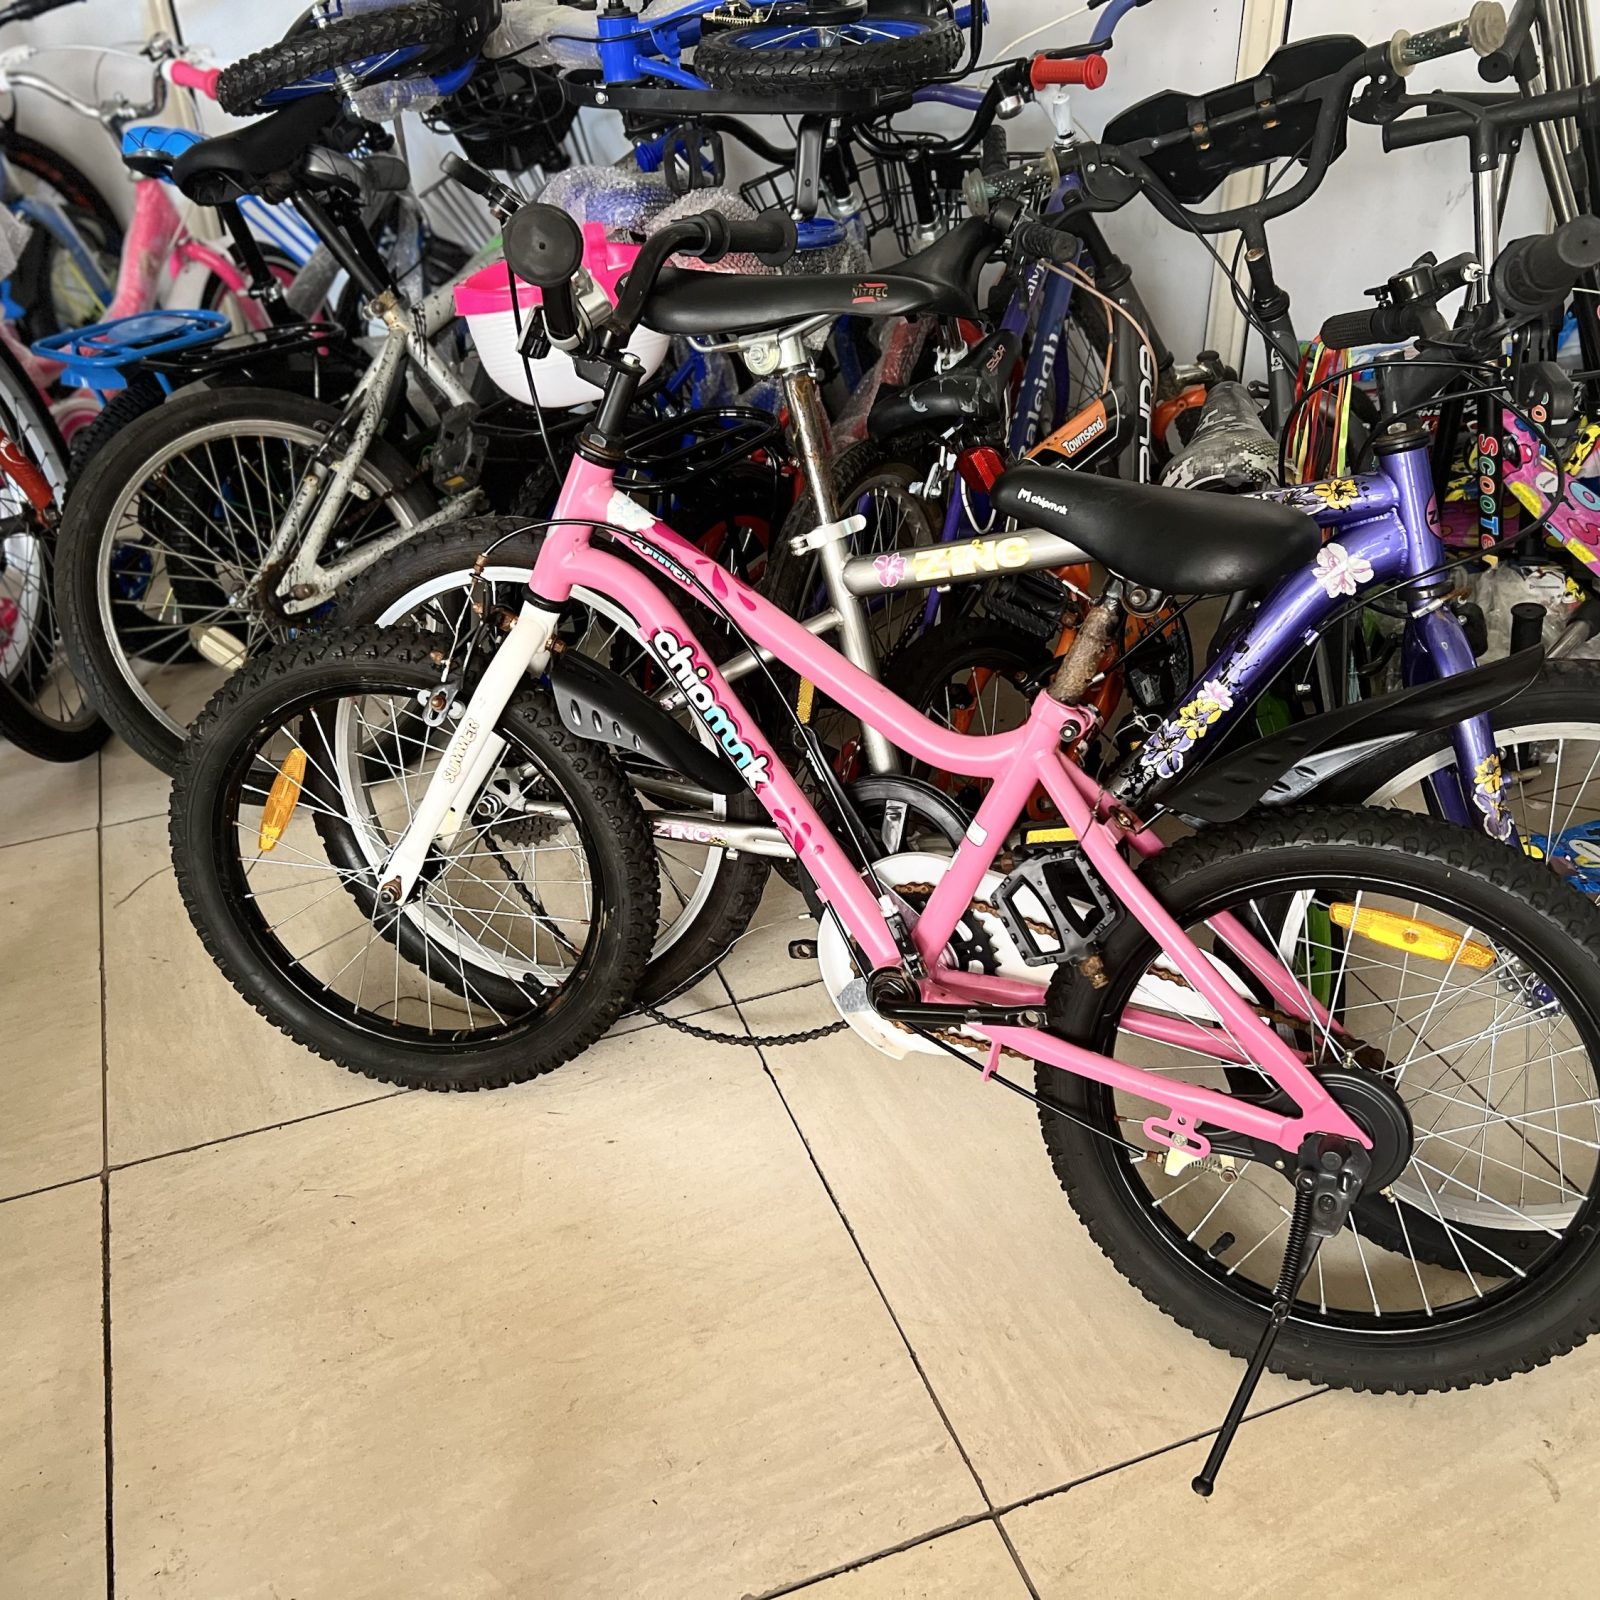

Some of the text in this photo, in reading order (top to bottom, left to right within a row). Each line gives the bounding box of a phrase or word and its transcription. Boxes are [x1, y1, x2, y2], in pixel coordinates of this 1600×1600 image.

[1061, 416, 1105, 454] Townsend
[653, 629, 771, 790] chipmunk
[443, 718, 479, 783] SUMMER
